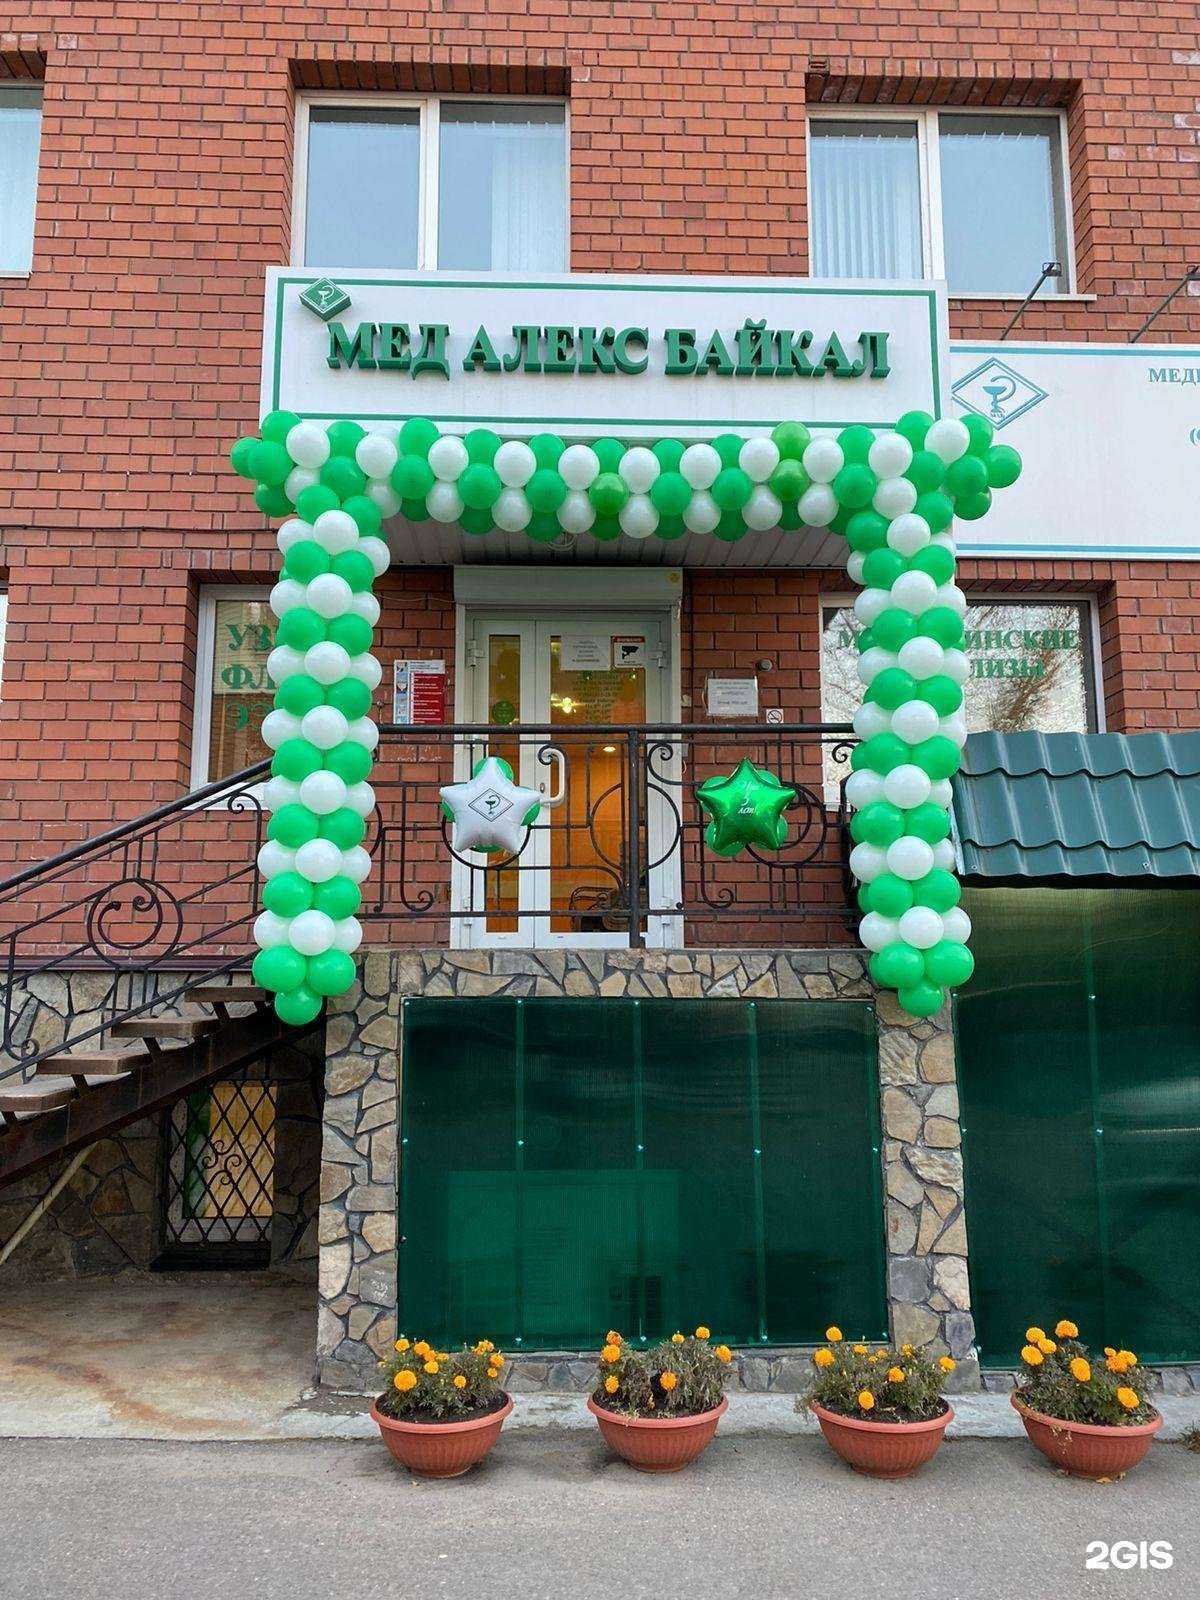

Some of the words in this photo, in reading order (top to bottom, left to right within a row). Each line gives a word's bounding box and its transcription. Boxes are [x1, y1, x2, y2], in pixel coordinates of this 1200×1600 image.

[327, 322, 450, 380] МЕД
[462, 324, 648, 374] АЛЕКС
[664, 318, 891, 377] БАЙКАЛ
[226, 624, 279, 651] УЗ
[222, 664, 277, 690] ФЛ
